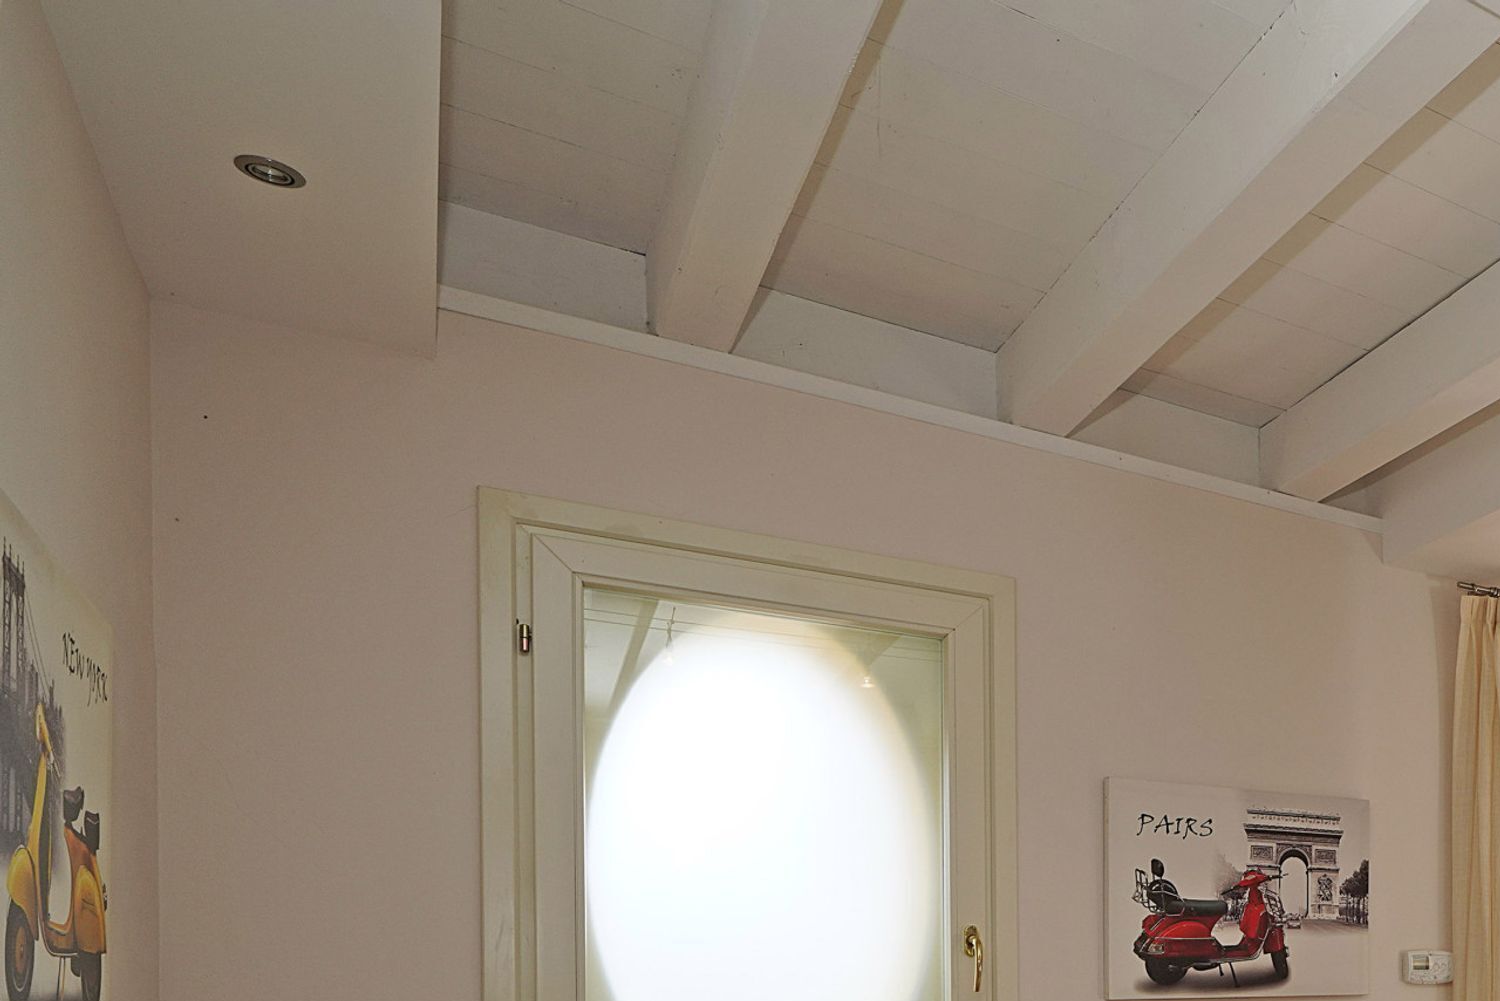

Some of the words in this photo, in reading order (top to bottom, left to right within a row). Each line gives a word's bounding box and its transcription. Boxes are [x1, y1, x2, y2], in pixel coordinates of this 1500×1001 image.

[62, 631, 84, 680] NEW
[86, 657, 108, 707] YORK
[1136, 813, 1213, 840] PAIRS
